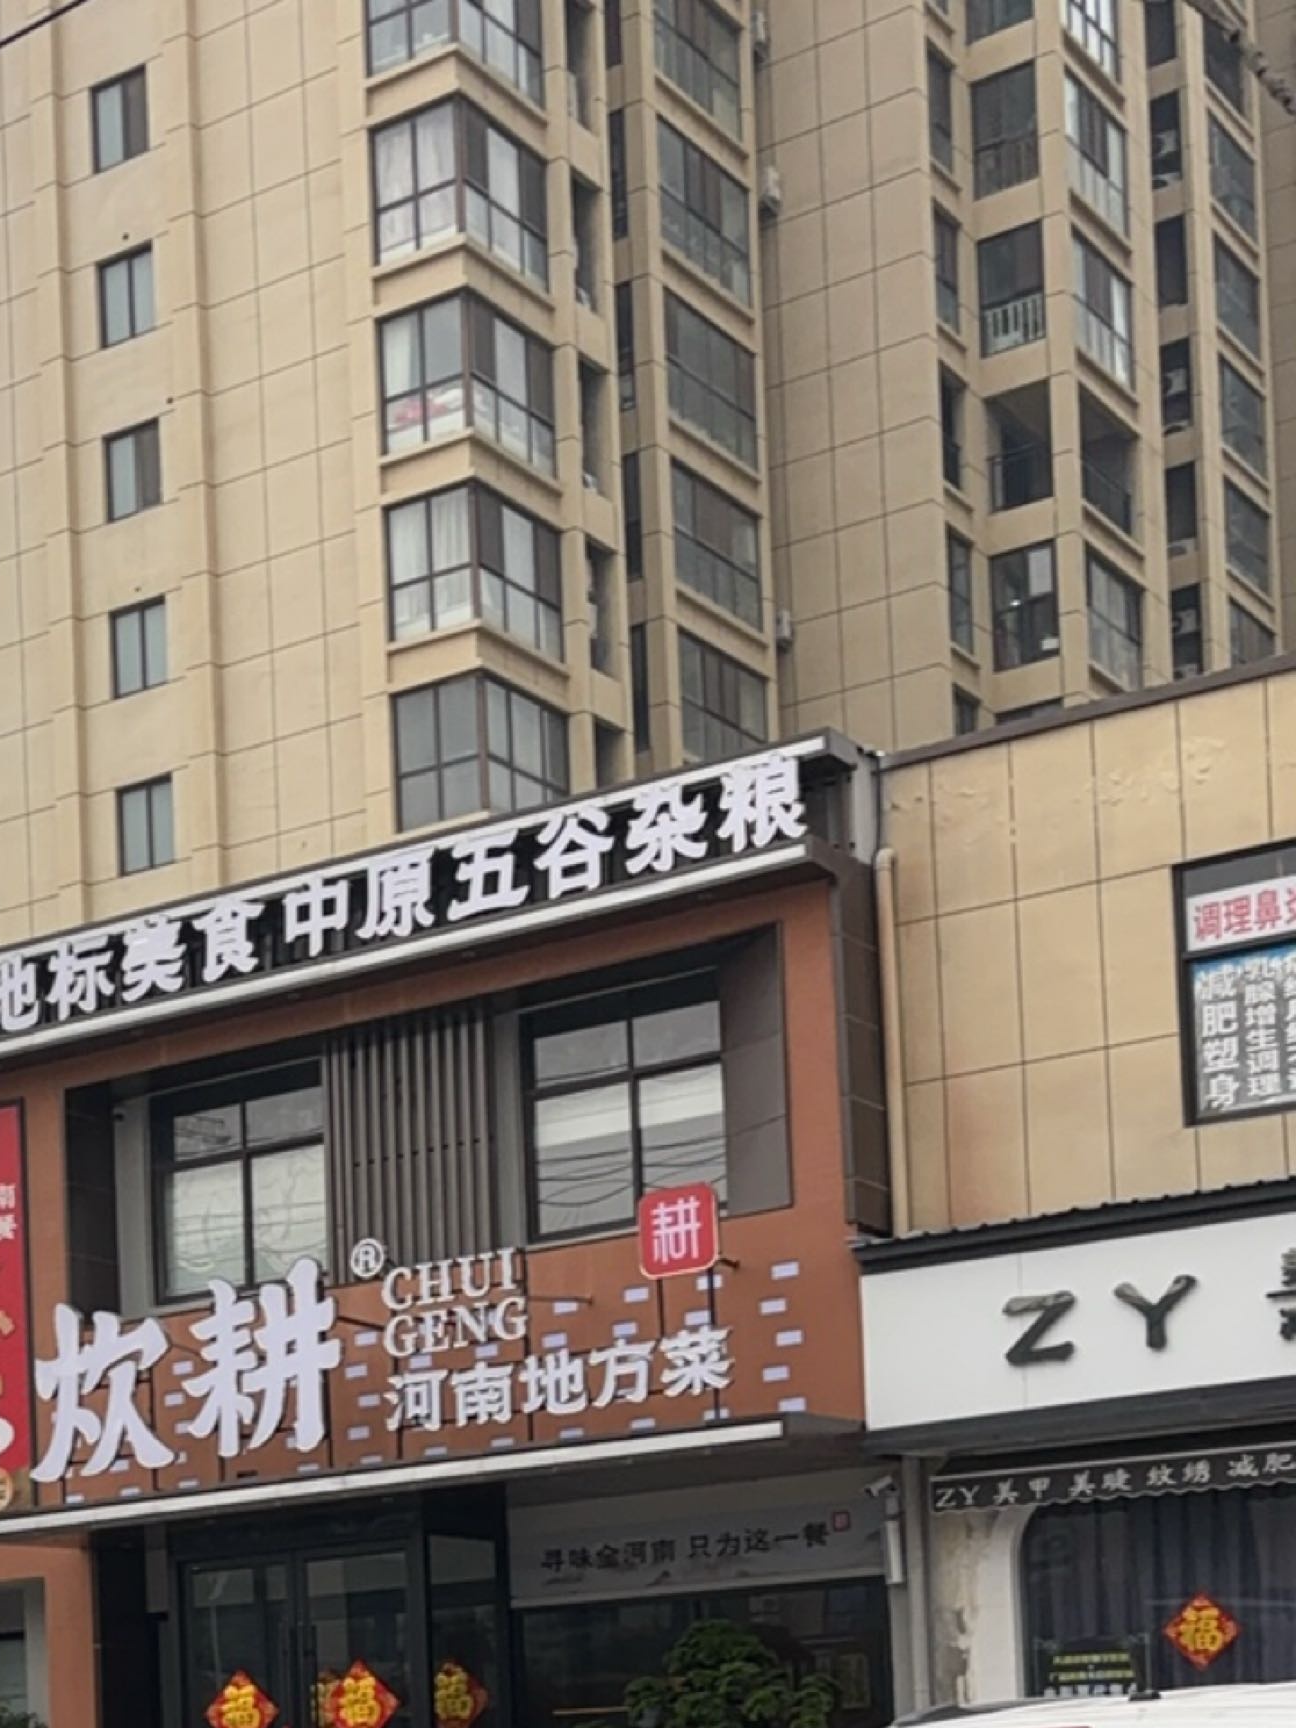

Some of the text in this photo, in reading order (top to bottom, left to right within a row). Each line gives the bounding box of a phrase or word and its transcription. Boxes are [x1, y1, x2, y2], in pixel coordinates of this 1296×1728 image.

[380, 1248, 523, 1312] CHUI
[382, 1296, 528, 1358] GENG
[29, 1256, 342, 1483] 炊耕
[385, 1325, 735, 1433] 河南地方菜
[541, 1521, 830, 1573] 寻味全河南 只为这一餐
